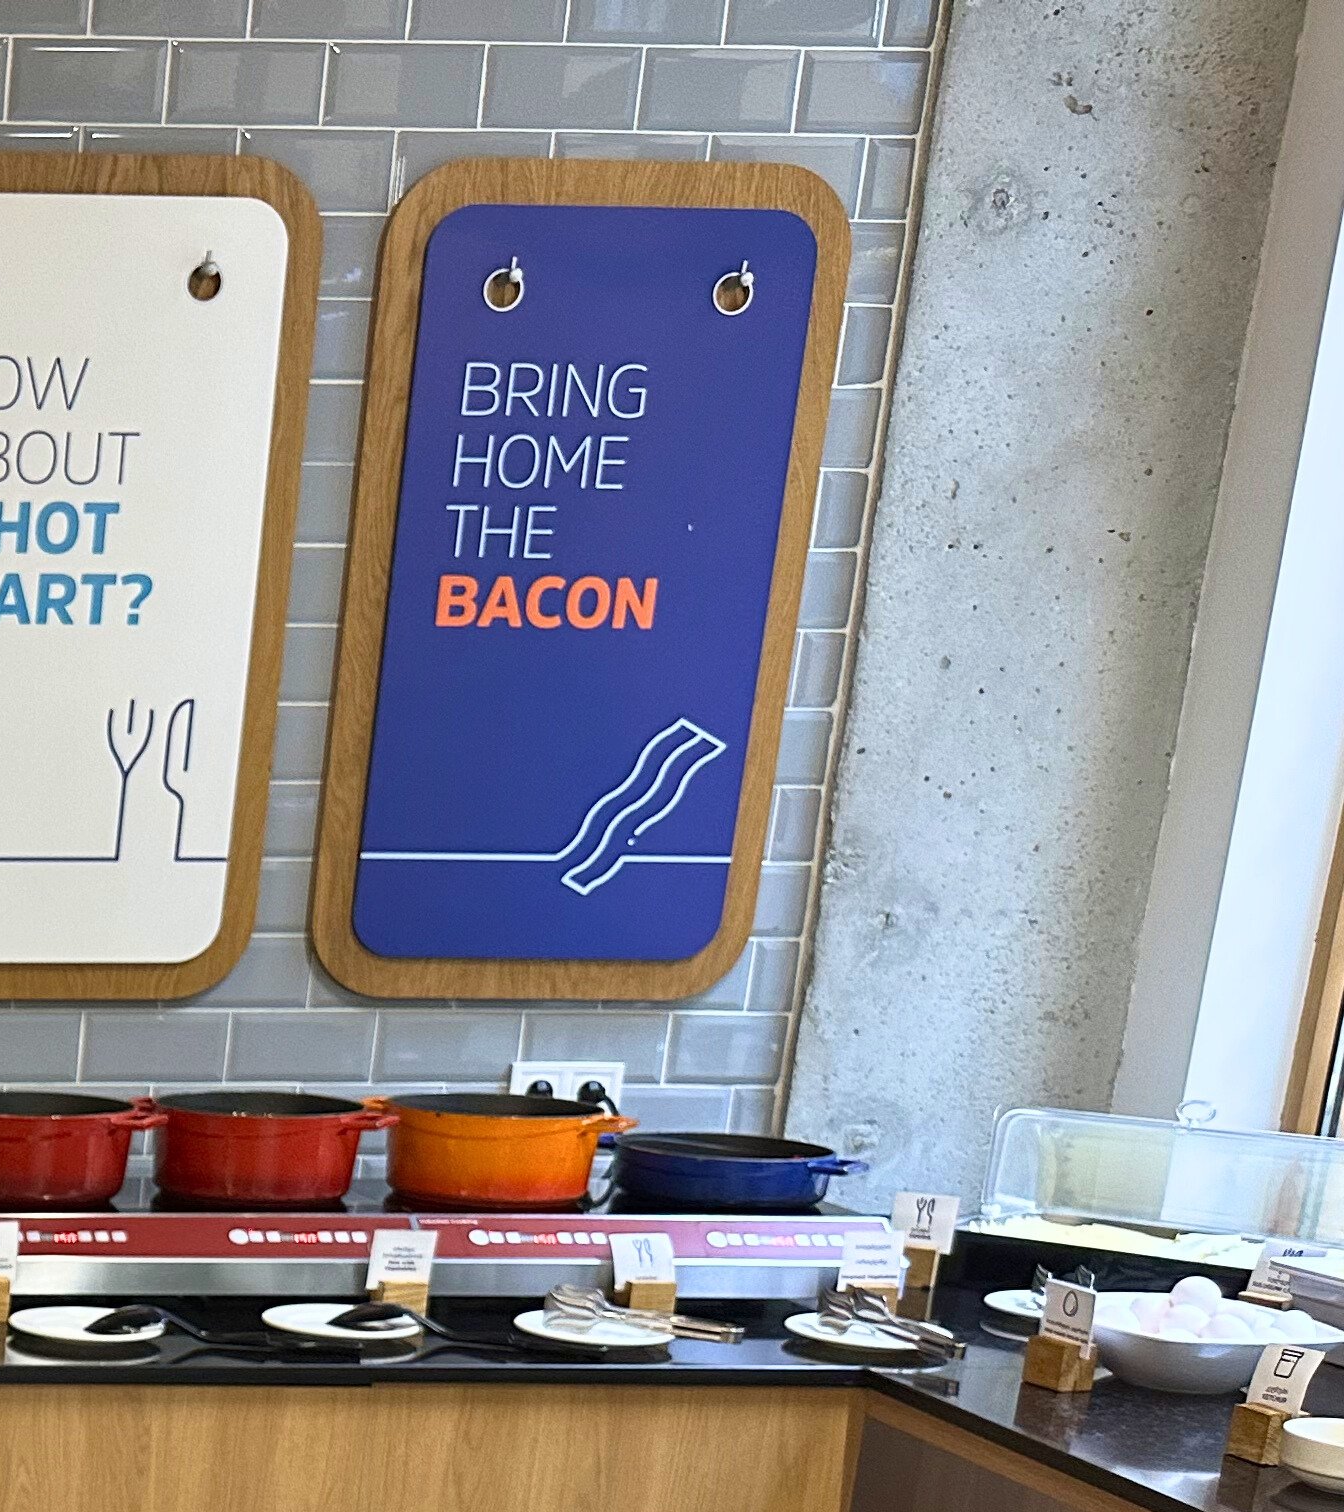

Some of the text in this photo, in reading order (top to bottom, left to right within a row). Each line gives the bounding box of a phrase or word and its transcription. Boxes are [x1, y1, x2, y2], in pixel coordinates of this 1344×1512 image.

[461, 362, 648, 419] BRING
[452, 434, 630, 490] HOME
[445, 505, 558, 560] THE
[434, 574, 659, 630] BACON
